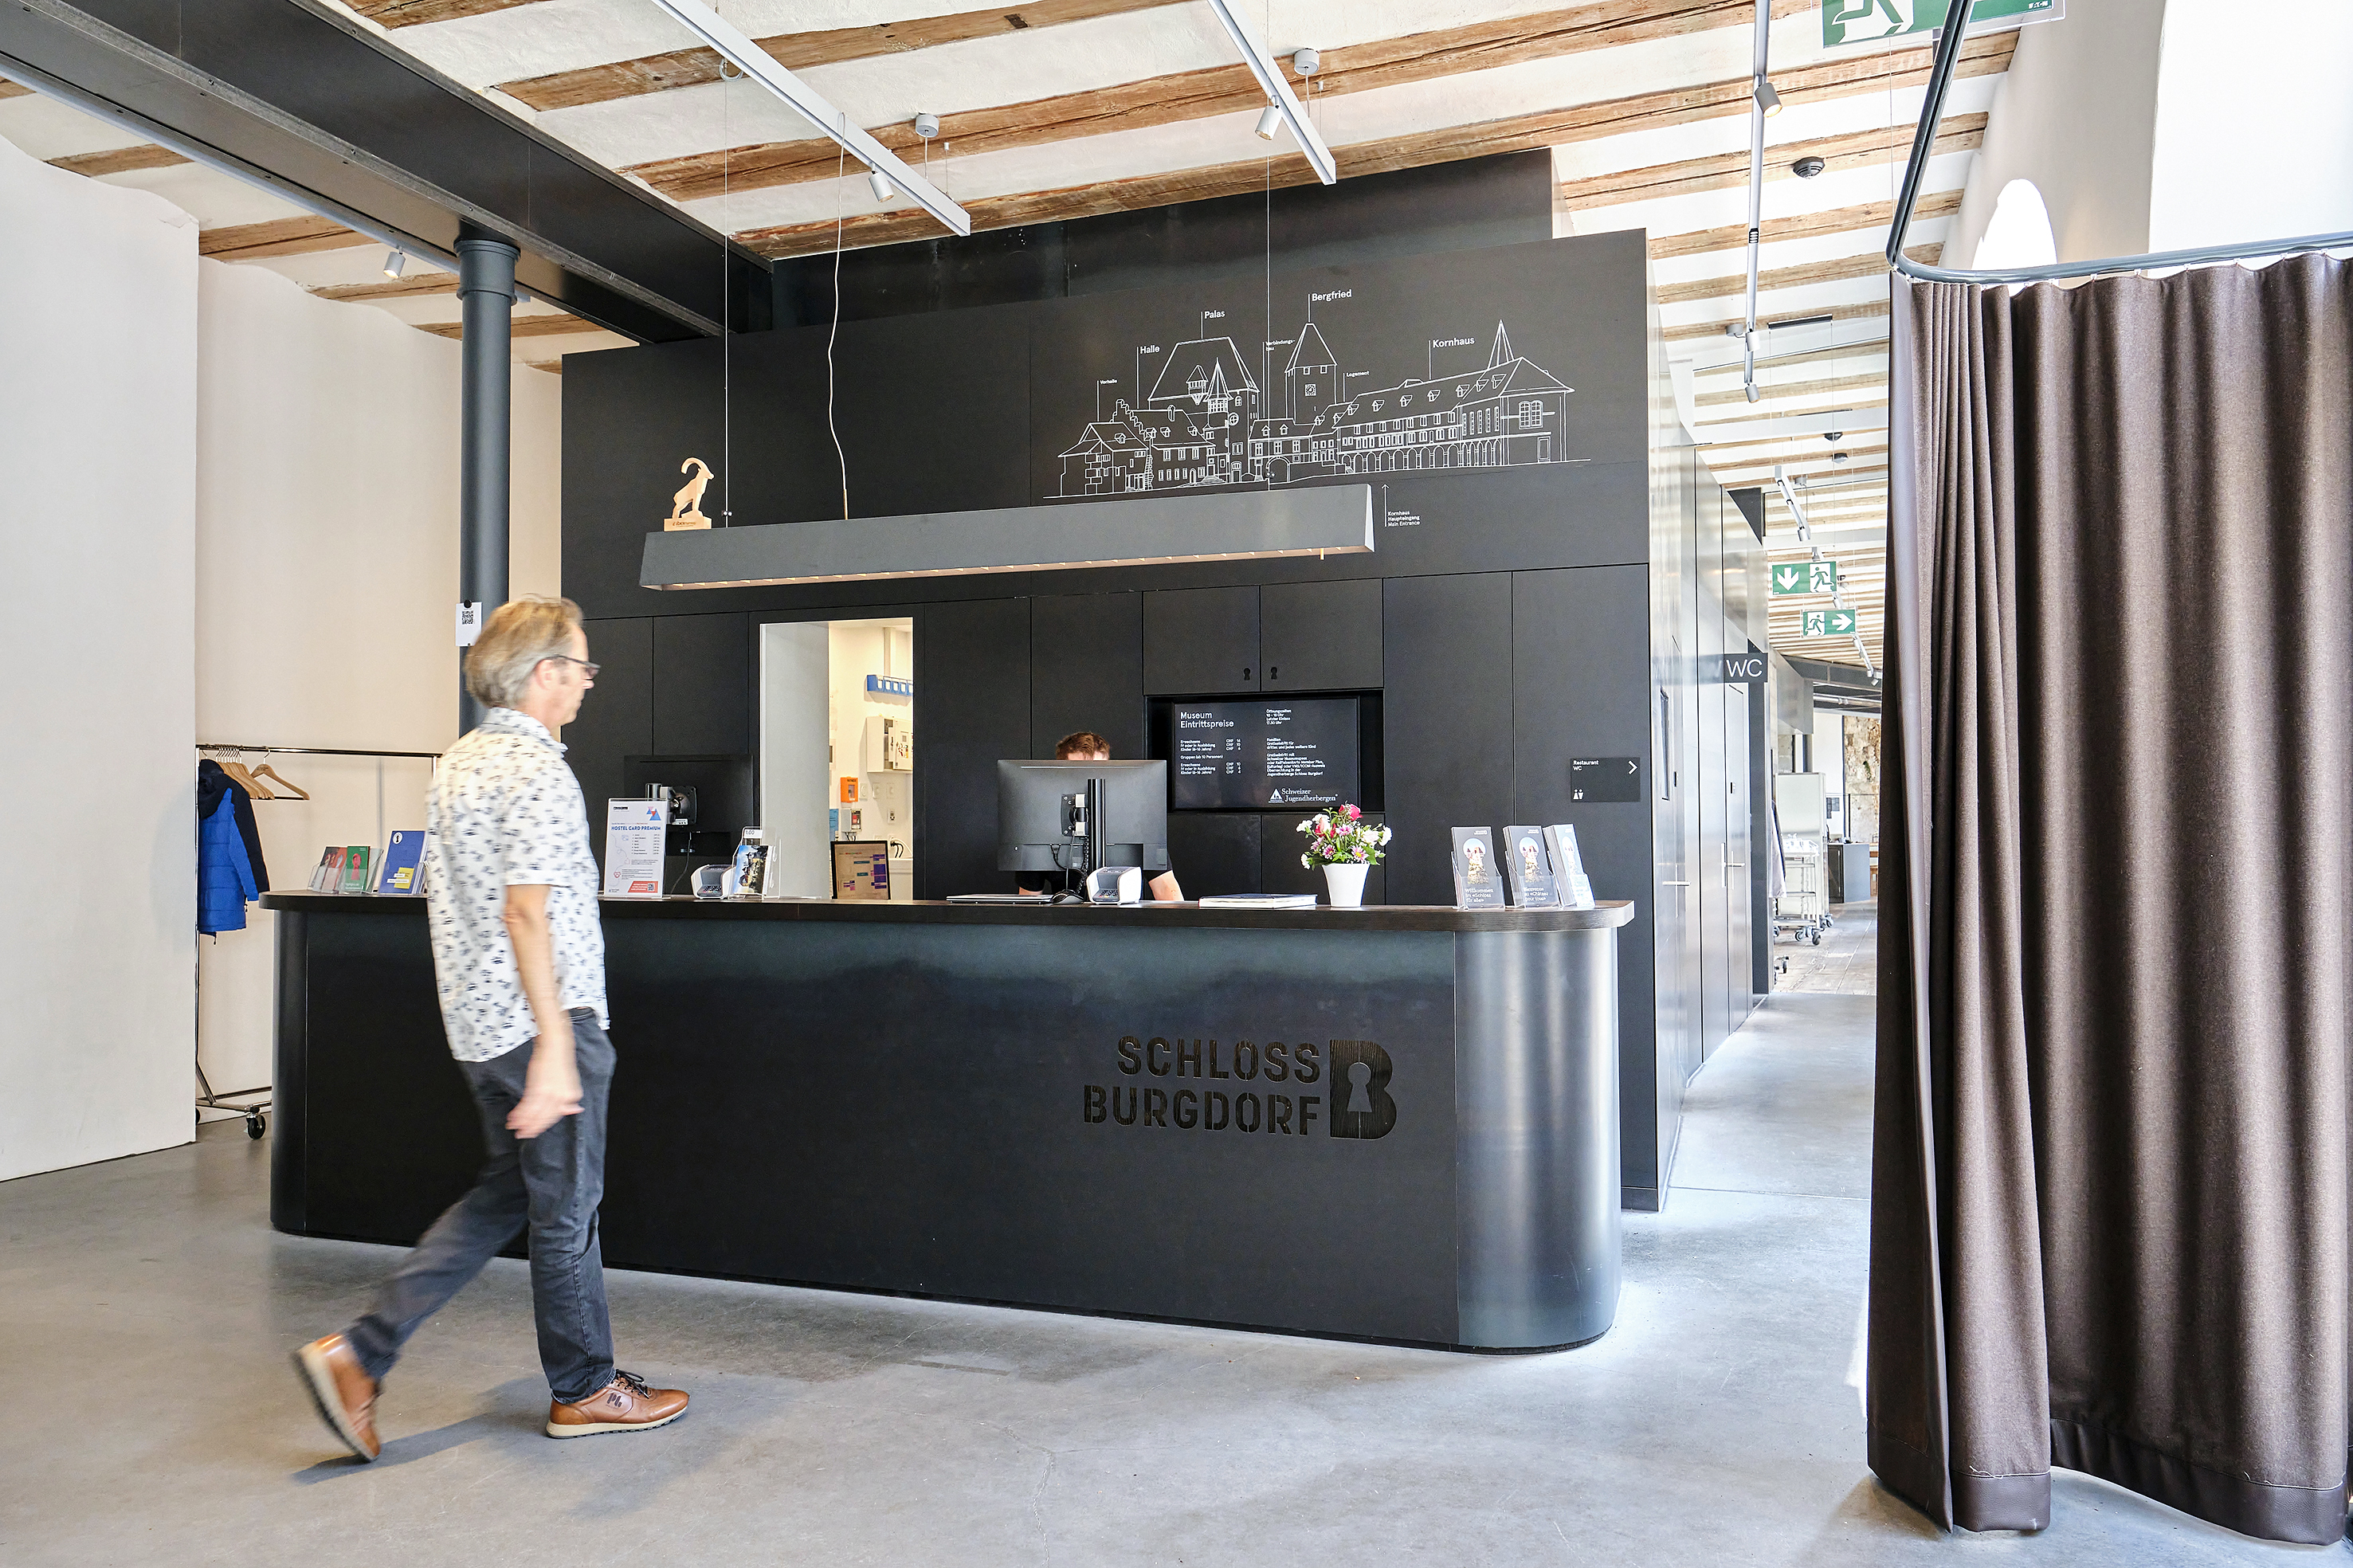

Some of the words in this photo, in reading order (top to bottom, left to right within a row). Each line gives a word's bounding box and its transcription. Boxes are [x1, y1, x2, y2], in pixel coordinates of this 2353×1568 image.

[1312, 288, 1352, 302] Bergfried
[1204, 310, 1226, 319] Palas
[1433, 336, 1475, 348] Kornhaus
[1139, 344, 1160, 354] Halle
[1726, 658, 1763, 677] WC
[1180, 719, 1234, 729] Eintrittspreise
[1284, 794, 1336, 803] Jugendherbergen
[1117, 1036, 1320, 1084] SCHLOSS
[1330, 1039, 1398, 1140] B
[1084, 1084, 1321, 1136] BURGDORF
